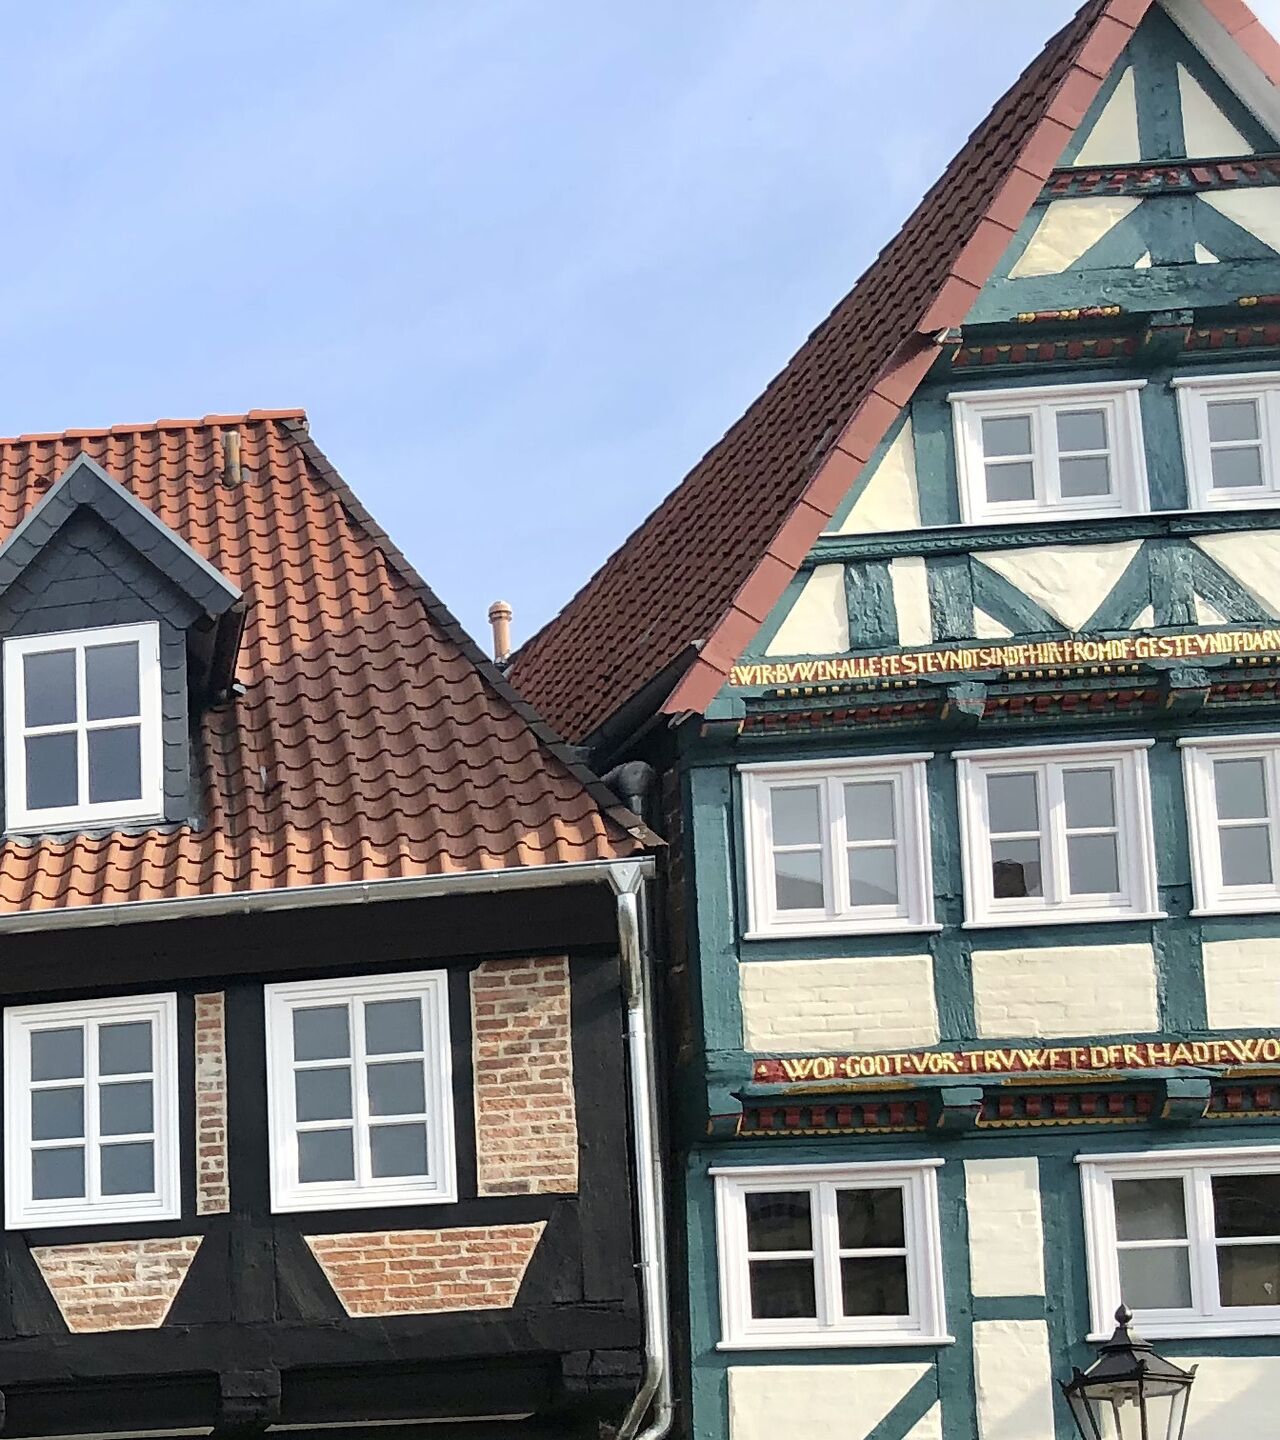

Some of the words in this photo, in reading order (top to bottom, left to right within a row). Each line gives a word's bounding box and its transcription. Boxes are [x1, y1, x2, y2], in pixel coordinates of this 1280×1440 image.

[736, 664, 775, 686] WIR
[839, 656, 880, 679] ALLE
[881, 652, 939, 676] FESTE
[1135, 634, 1197, 659] GESTE
[845, 1054, 908, 1077] GODT
[909, 1051, 959, 1073] VOR
[1090, 1044, 1146, 1067] DER
[1146, 1040, 1227, 1065] HADT
